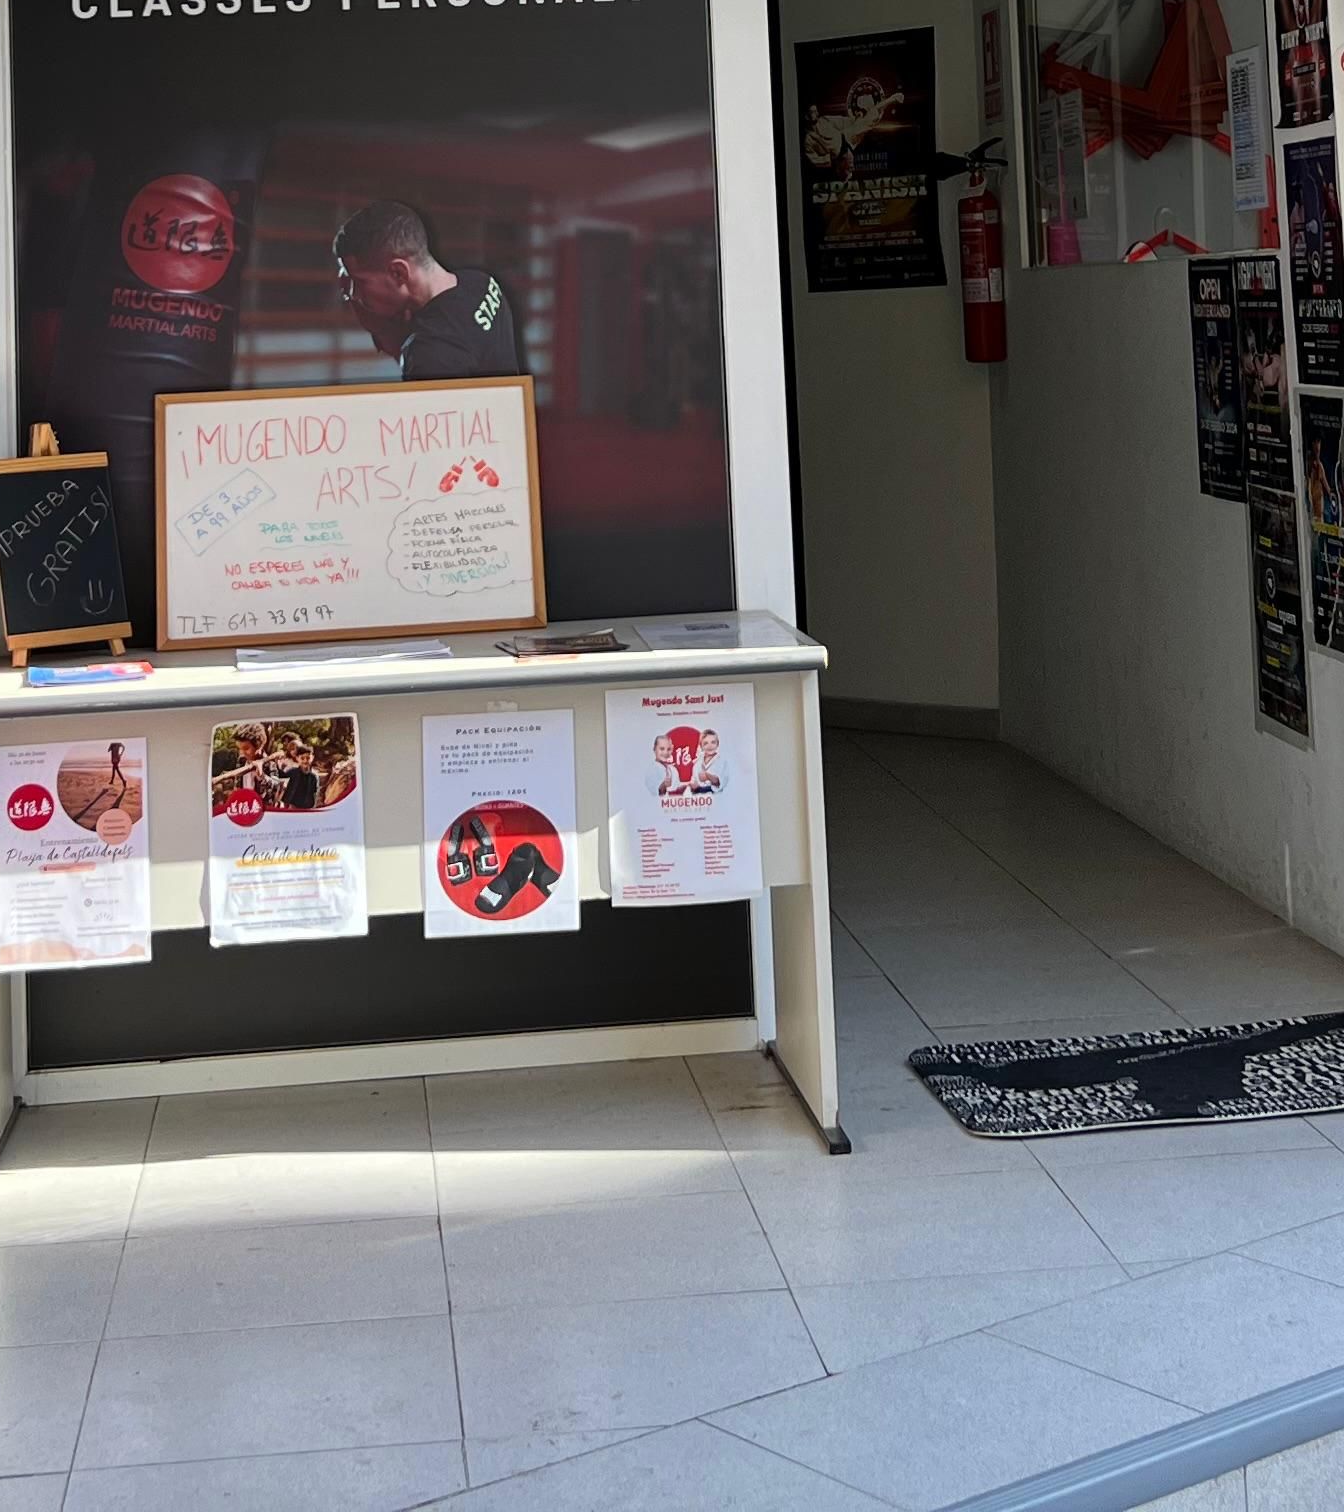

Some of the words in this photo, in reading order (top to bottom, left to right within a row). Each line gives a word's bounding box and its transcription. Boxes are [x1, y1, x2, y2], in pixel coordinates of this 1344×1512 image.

[812, 175, 928, 204] SPANISH
[1199, 278, 1221, 300] OPEN
[111, 287, 224, 322] MUGENDO
[108, 314, 179, 337] MARTIAL
[180, 324, 218, 342] ARTS
[379, 407, 501, 457] MARTIAL
[317, 463, 417, 511] ARTS!
[187, 504, 215, 526] DE
[218, 491, 232, 504] 3
[195, 528, 208, 540] A
[258, 522, 297, 534] PARA
[224, 562, 242, 577] NO
[227, 612, 259, 630] 617
[267, 610, 286, 625] 73
[292, 608, 309, 623] 69
[315, 605, 335, 620] 97
[661, 796, 713, 808] MUGENDO
[6, 849, 42, 867] Playa
